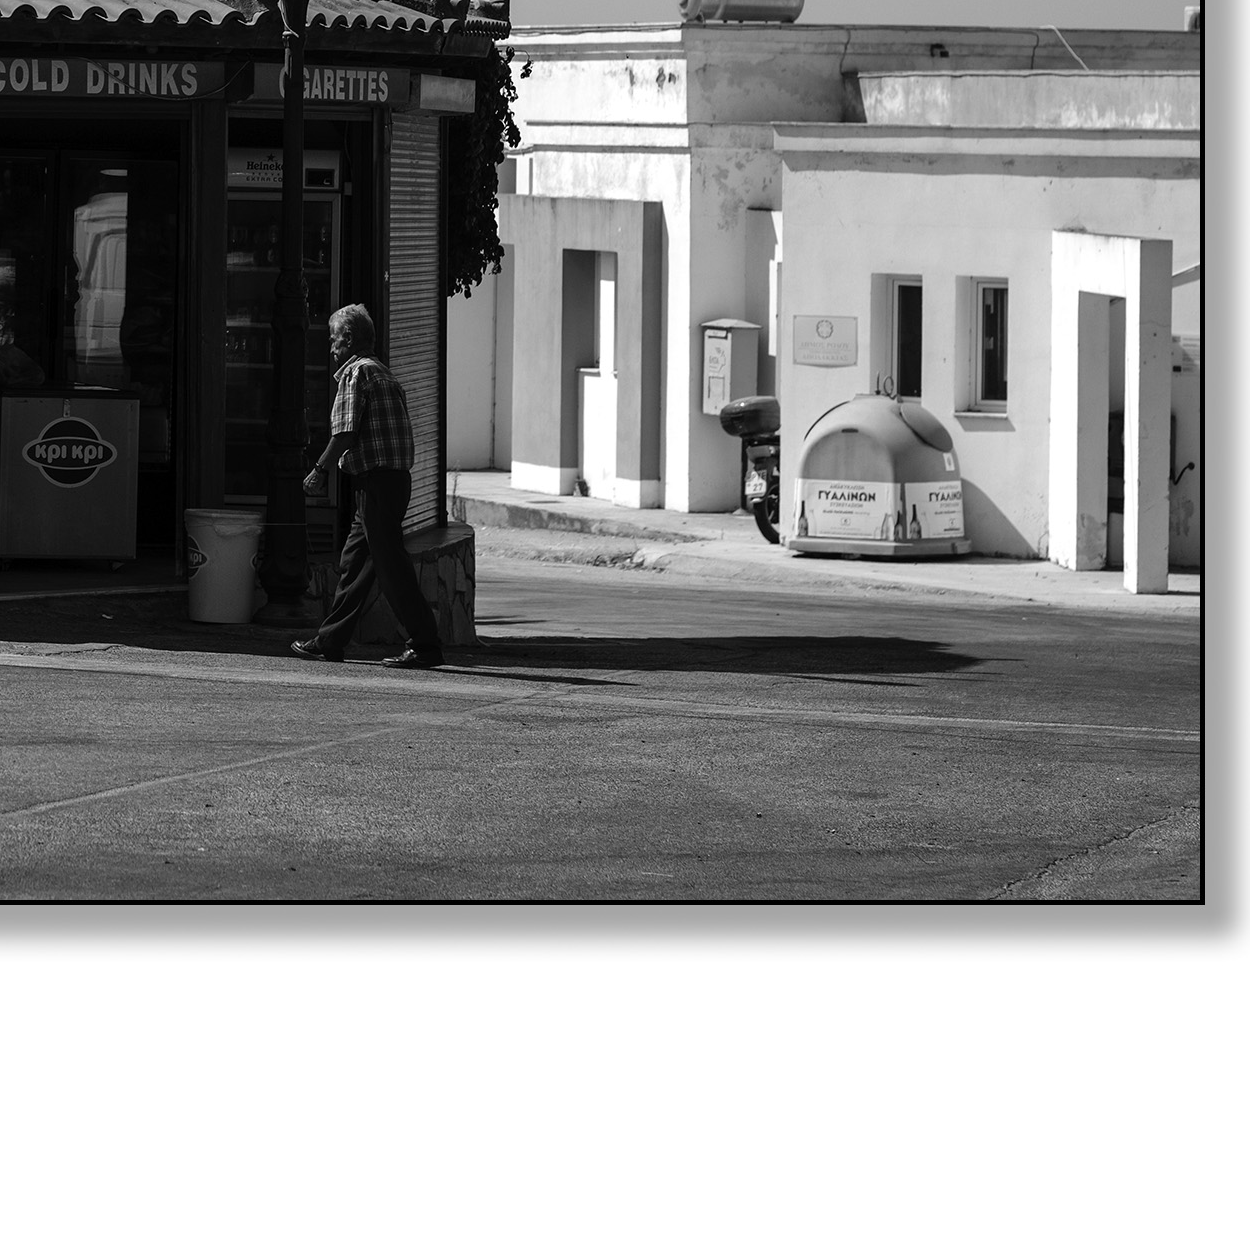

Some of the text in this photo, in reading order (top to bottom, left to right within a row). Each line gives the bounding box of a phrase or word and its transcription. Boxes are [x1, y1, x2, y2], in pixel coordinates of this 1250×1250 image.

[86, 61, 198, 96] DRINKS
[278, 66, 389, 102] CGARETTES
[246, 161, 283, 171] Heinek
[818, 490, 876, 502] ΓΥΑΛΙΝΩΝ
